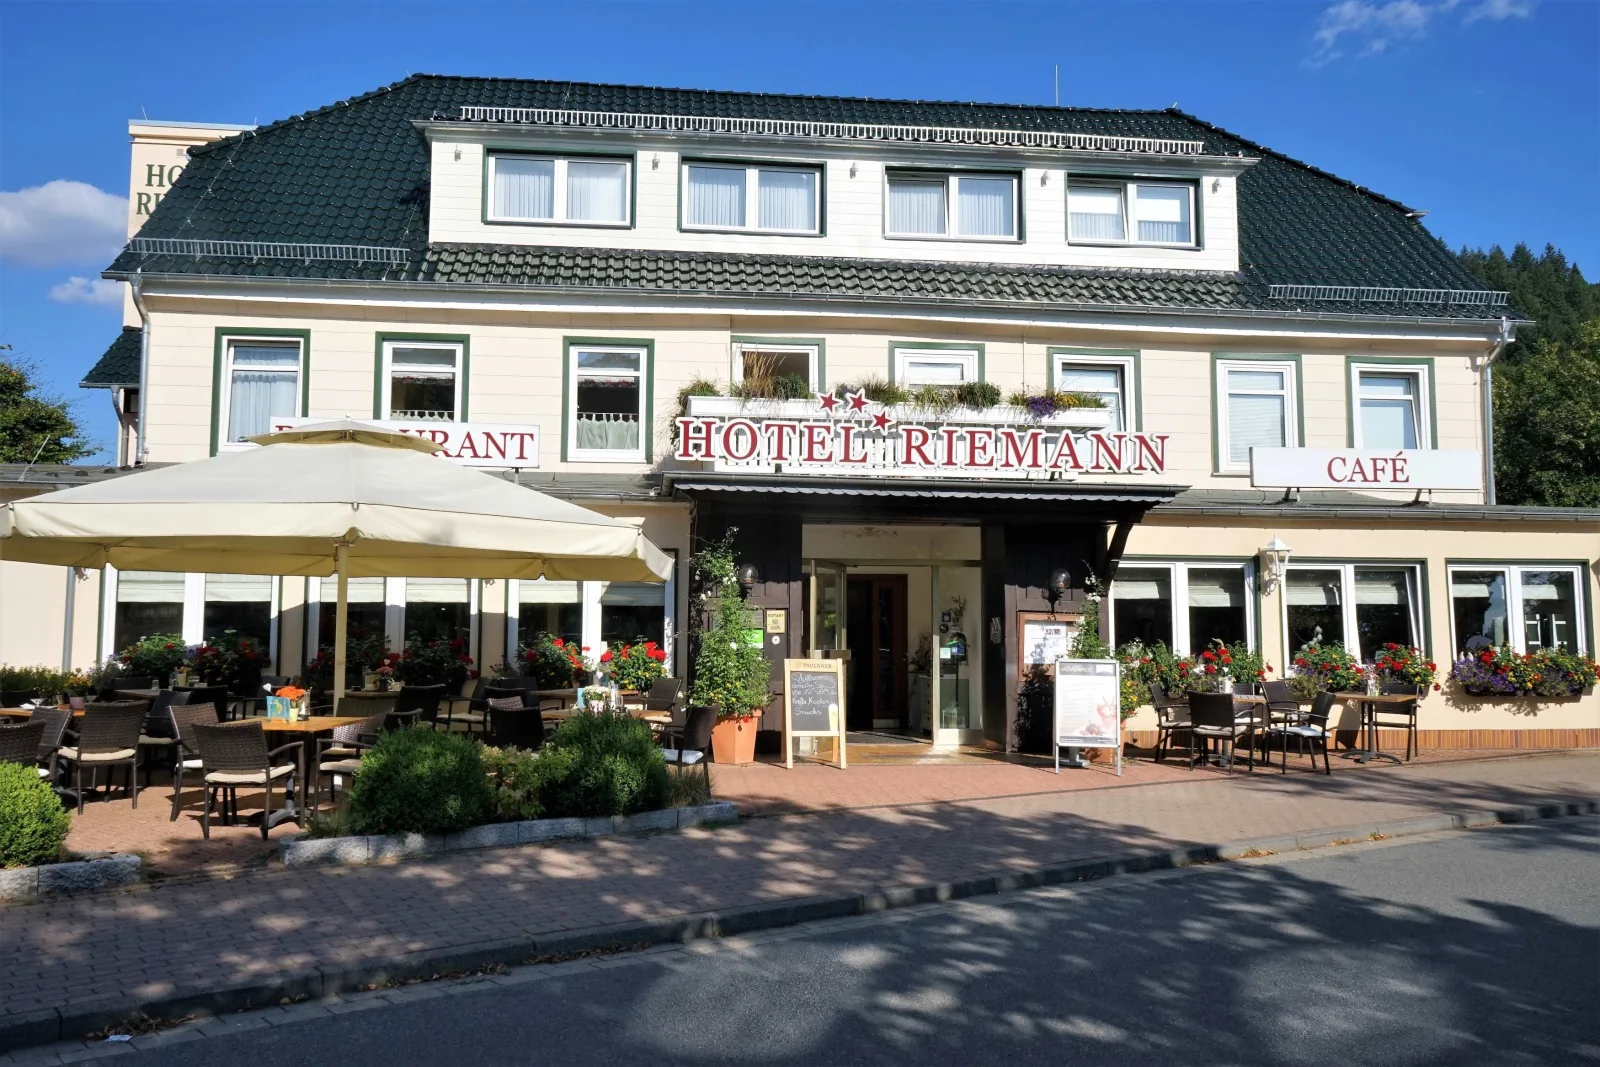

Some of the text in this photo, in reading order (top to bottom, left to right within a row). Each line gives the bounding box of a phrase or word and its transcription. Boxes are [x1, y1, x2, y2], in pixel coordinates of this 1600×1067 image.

[145, 164, 184, 187] HO
[136, 192, 161, 215] RI
[677, 419, 1170, 473] HOTEL RIEMANN
[1327, 451, 1410, 482] CAFÉ
